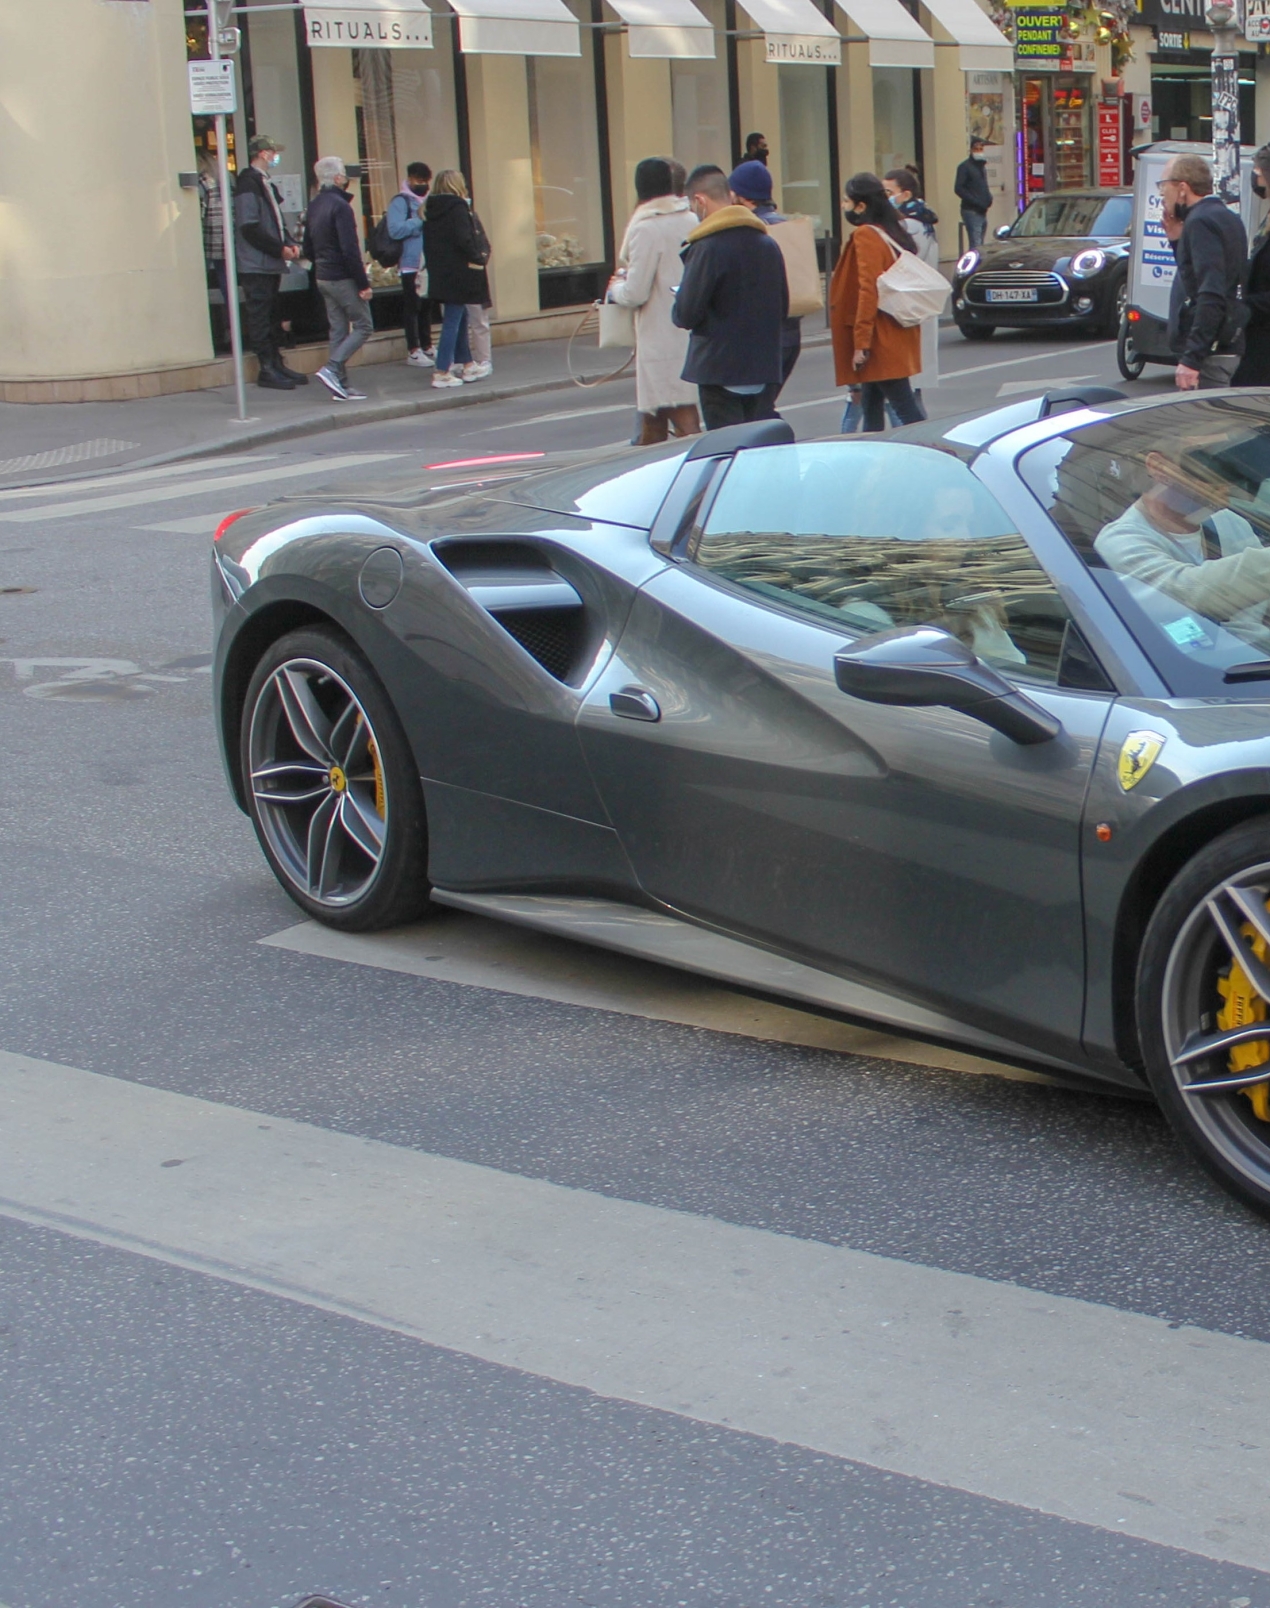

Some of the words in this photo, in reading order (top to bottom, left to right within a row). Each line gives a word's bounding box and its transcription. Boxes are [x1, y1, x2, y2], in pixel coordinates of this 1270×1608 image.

[311, 21, 428, 40] RITUALS...
[1018, 30, 1052, 41] PENDANT
[1159, 32, 1183, 48] SORTIE
[768, 43, 837, 59] RITUALS...
[1144, 252, 1175, 262] Réserva
